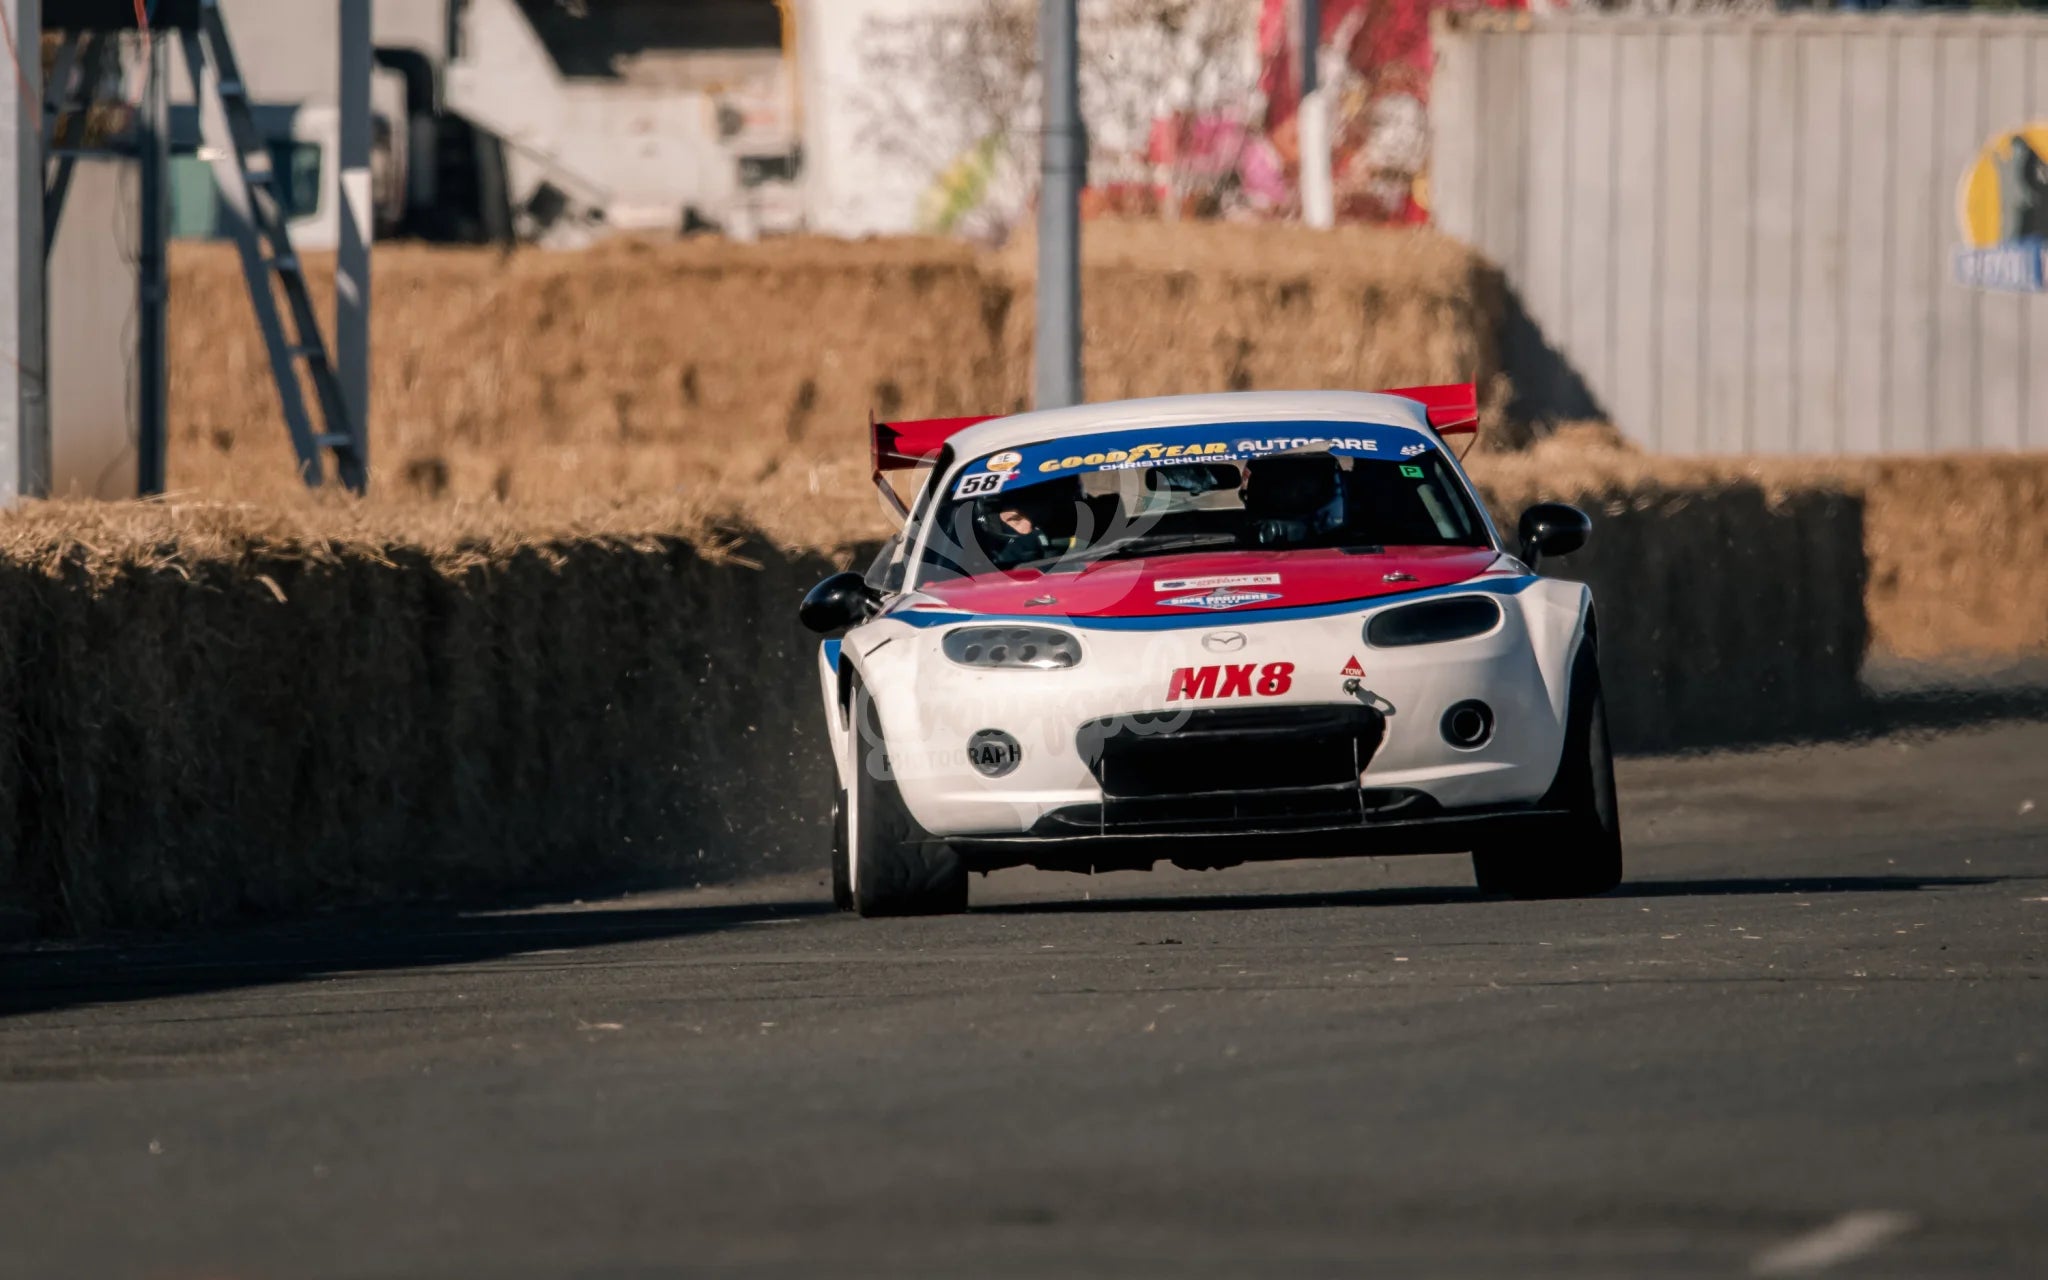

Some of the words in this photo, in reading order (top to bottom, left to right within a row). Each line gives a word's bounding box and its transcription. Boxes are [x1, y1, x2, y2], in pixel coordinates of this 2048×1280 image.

[1039, 443, 1228, 473] GOODYEAR
[1099, 453, 1237, 471] CHRISTCHURCH
[962, 474, 1000, 494] 58
[1166, 661, 1295, 701] MX8
[1345, 668, 1362, 676] TOW
